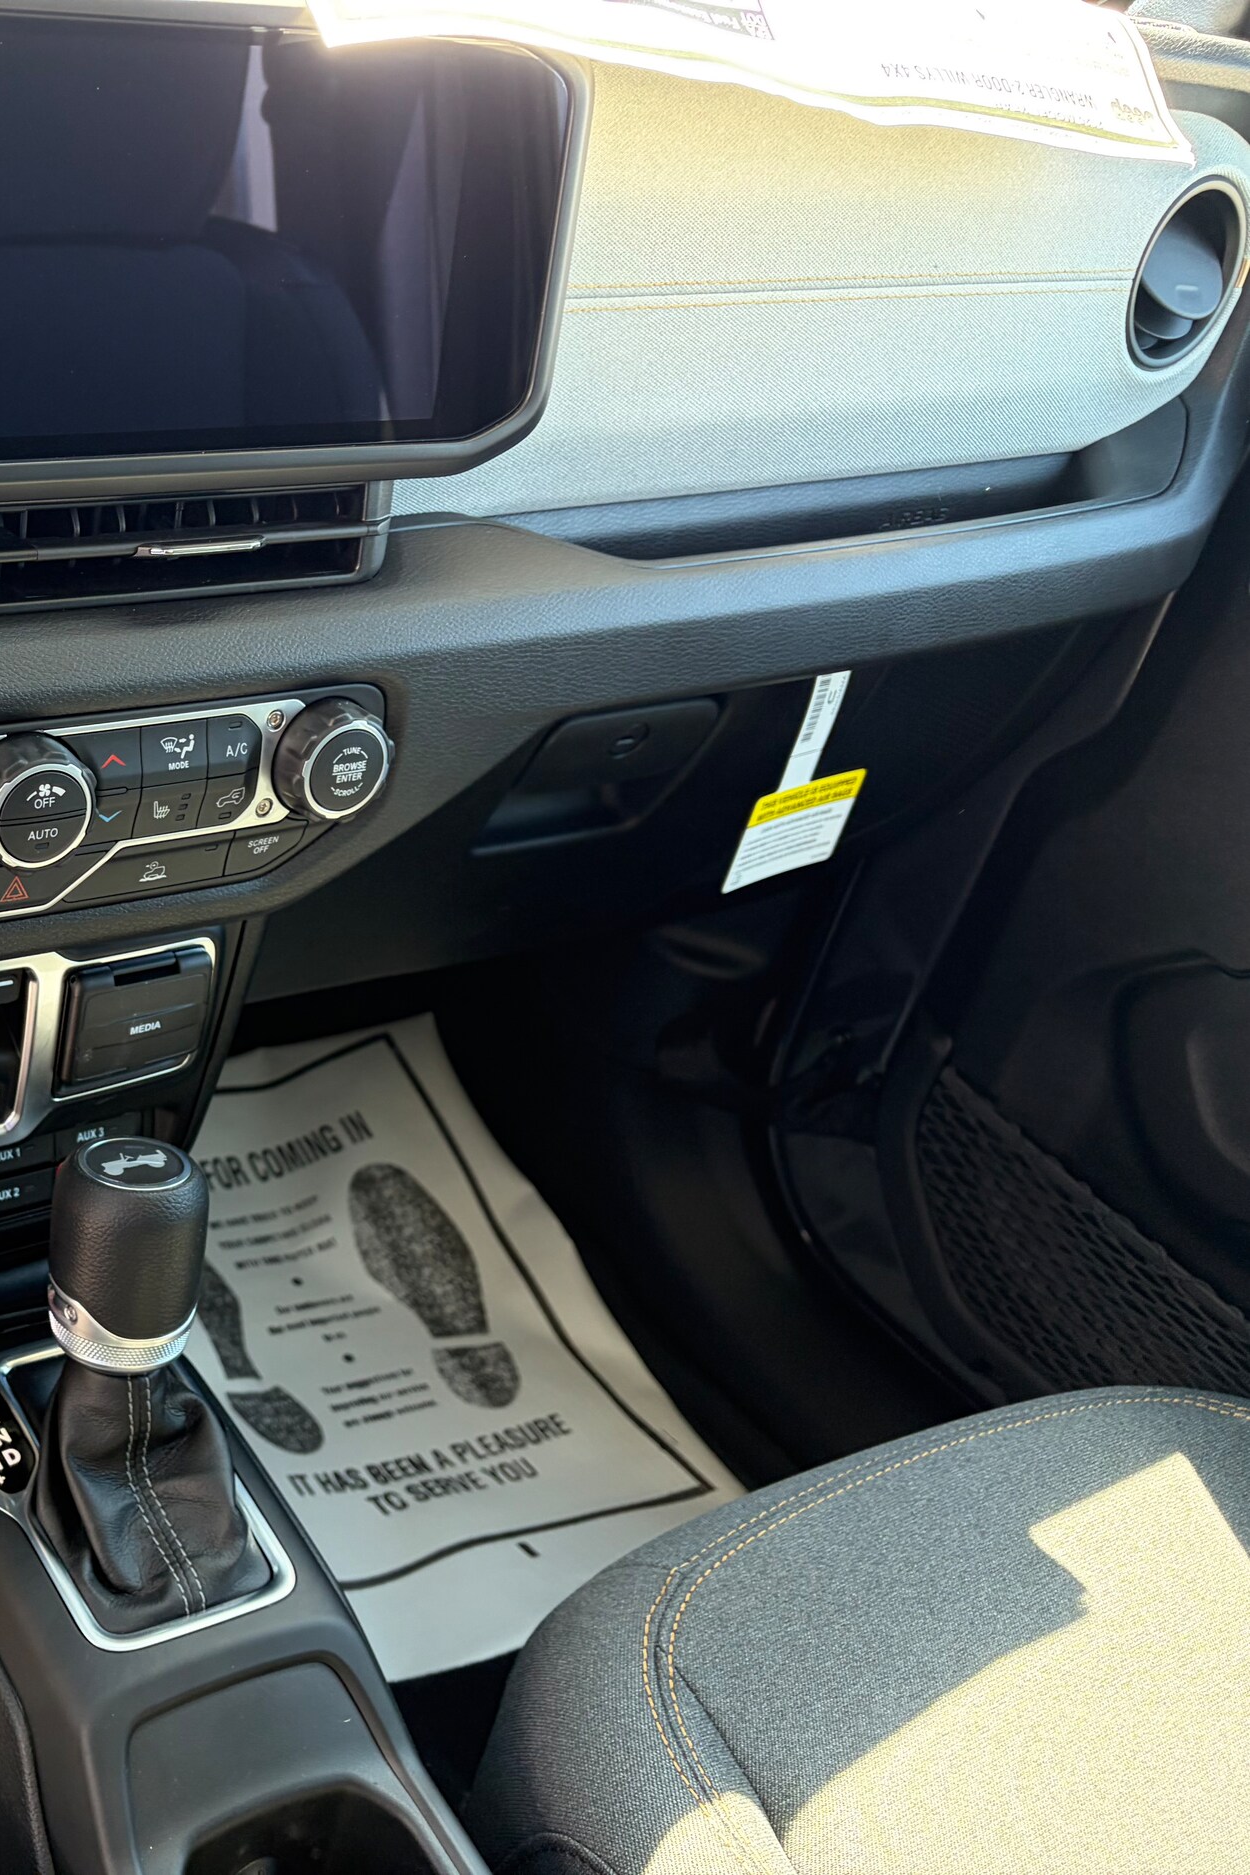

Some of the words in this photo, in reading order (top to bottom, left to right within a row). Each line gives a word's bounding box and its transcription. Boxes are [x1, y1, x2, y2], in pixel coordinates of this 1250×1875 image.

[881, 63, 910, 77] 4X4
[914, 65, 967, 85] WILLYS
[975, 73, 1025, 96] 2-DOOR
[1029, 83, 1096, 108] WRANGLER
[225, 742, 248, 758] A/C
[342, 746, 362, 756] TUNE
[168, 760, 190, 771] MODE
[332, 760, 368, 773] BROWSE
[335, 772, 363, 784] ENTER
[333, 786, 360, 797] SCROLL
[33, 796, 56, 810] OFF
[28, 826, 59, 841] AUTO
[248, 835, 280, 849] SCREEN
[253, 844, 270, 855] OFF
[130, 1020, 161, 1036] MEDIA
[76, 1129, 96, 1143] AUX
[97, 1127, 105, 1138] 3
[16, 1148, 21, 1158] 1
[200, 1155, 252, 1193] FOR
[247, 1123, 344, 1183] COMING
[339, 1109, 374, 1145] IN
[12, 1187, 20, 1198] 2
[1, 1448, 22, 1466] D
[286, 1472, 315, 1499] IT
[314, 1462, 369, 1496] HAS
[367, 1453, 432, 1487] BEEN
[433, 1442, 455, 1471] A
[450, 1412, 574, 1466] PLEASURE
[366, 1488, 410, 1518] TO
[411, 1470, 487, 1505] SERVE
[487, 1458, 539, 1489] YOU
